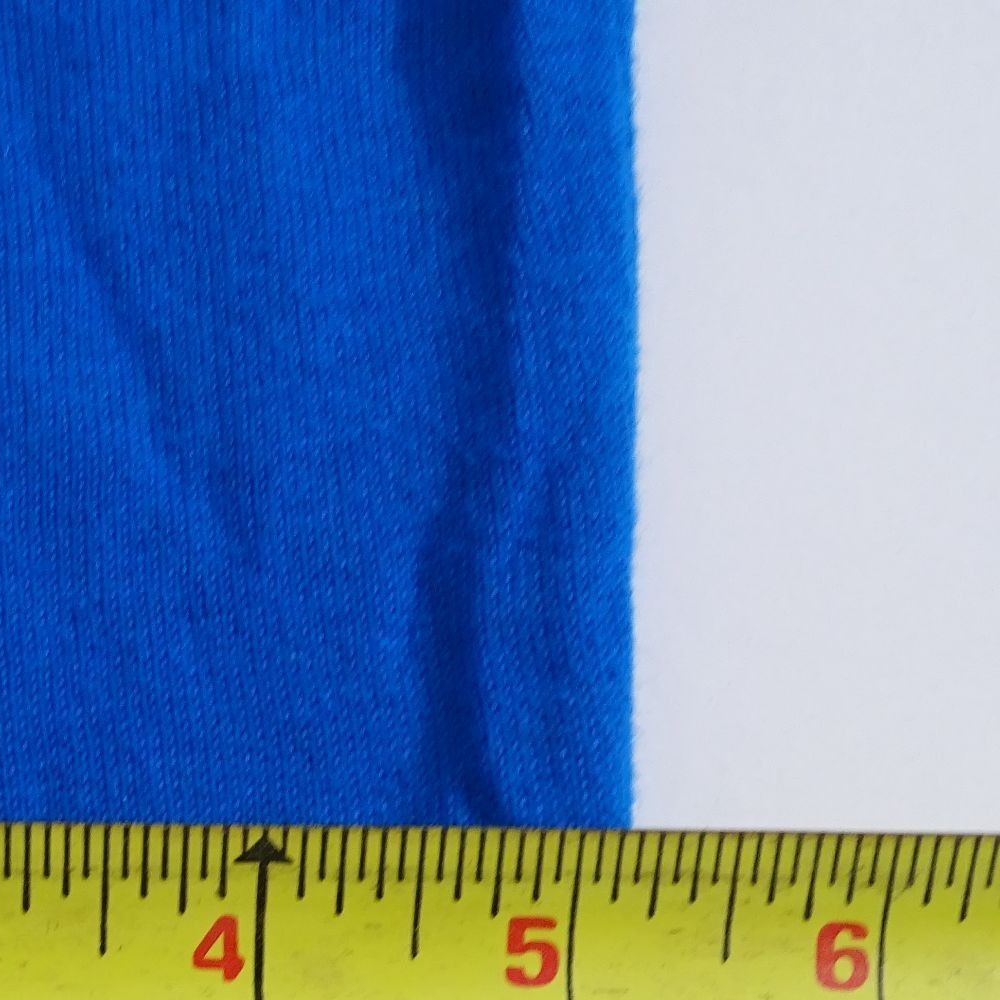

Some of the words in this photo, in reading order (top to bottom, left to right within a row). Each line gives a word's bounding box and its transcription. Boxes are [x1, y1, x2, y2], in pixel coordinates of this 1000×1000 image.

[192, 915, 245, 981] 4
[505, 916, 560, 987] 5
[815, 920, 869, 991] 6
